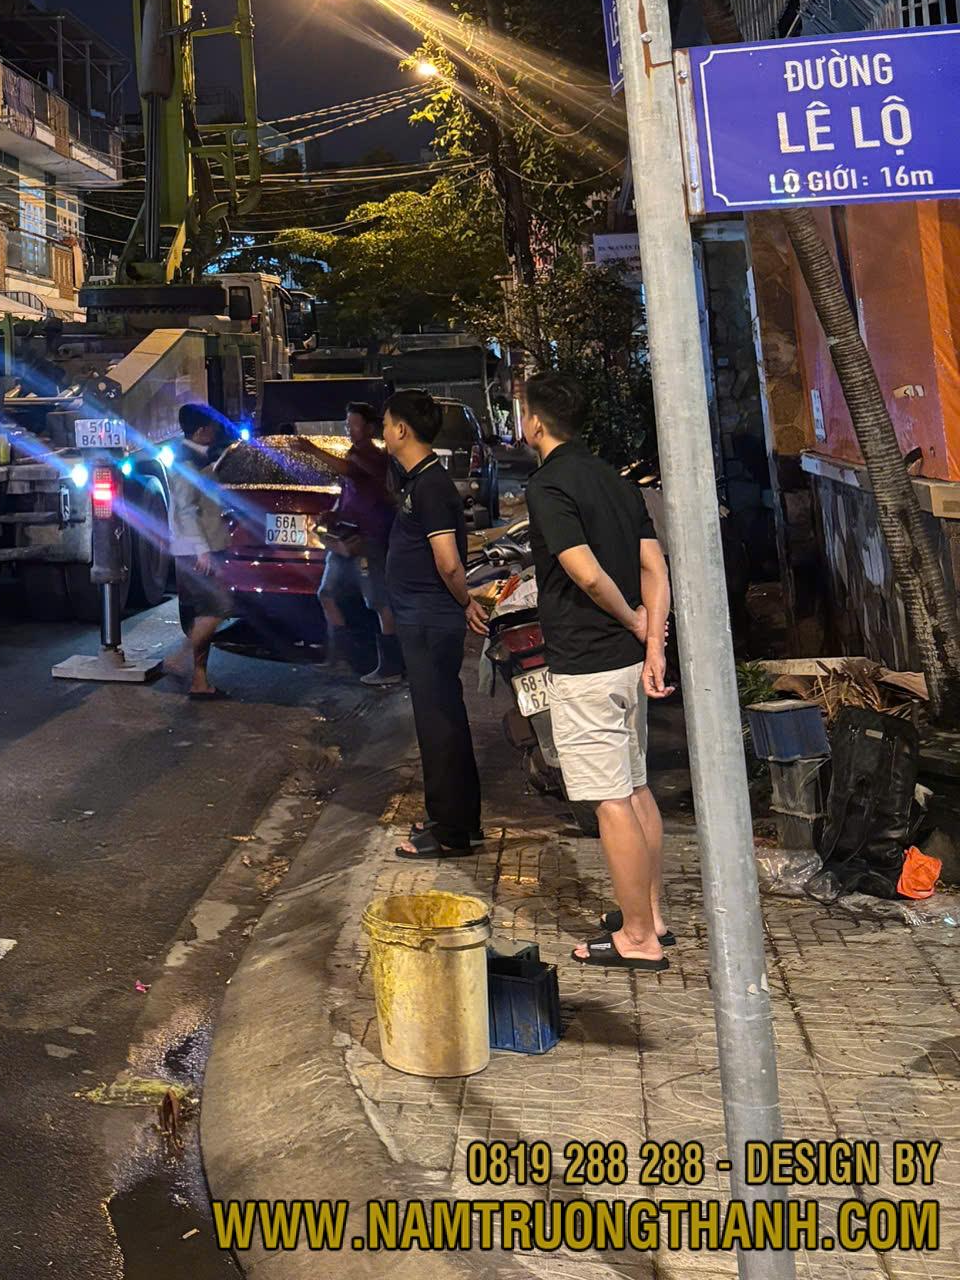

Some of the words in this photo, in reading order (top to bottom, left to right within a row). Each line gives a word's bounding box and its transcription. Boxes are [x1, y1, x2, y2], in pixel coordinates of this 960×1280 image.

[783, 48, 894, 92] ĐƯỜNG
[776, 100, 835, 154] LÊ
[850, 95, 913, 156] LỘ
[769, 169, 801, 197] LỘ
[880, 165, 934, 188] 16m
[267, 529, 305, 543] 073.07
[275, 516, 297, 529] 66A
